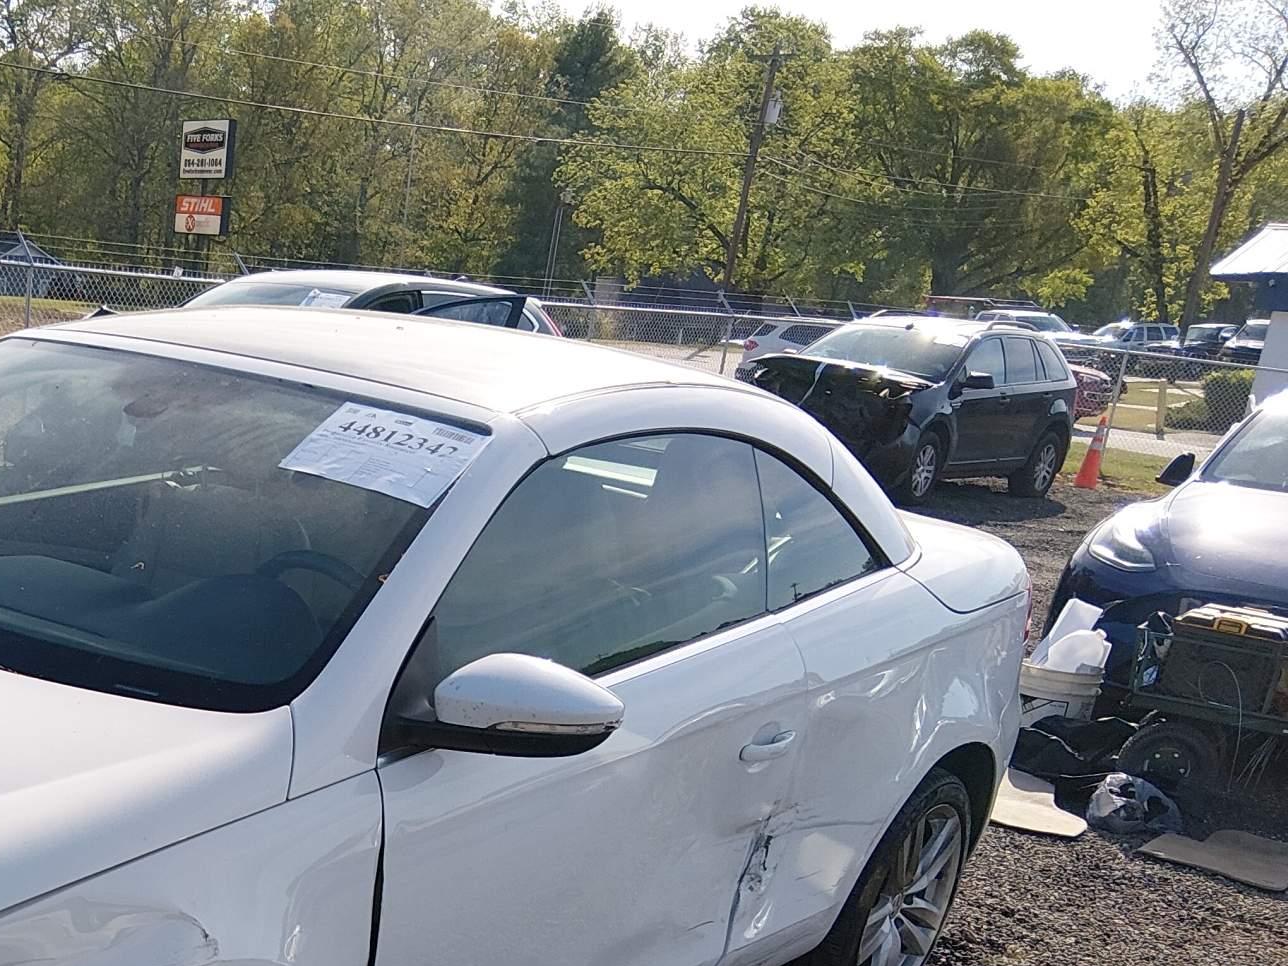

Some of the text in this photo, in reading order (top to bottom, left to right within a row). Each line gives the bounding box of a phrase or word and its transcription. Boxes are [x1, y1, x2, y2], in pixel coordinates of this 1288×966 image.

[186, 133, 223, 143] FIVE FORKS
[181, 199, 215, 213] STIHL
[338, 420, 459, 458] 44812342
